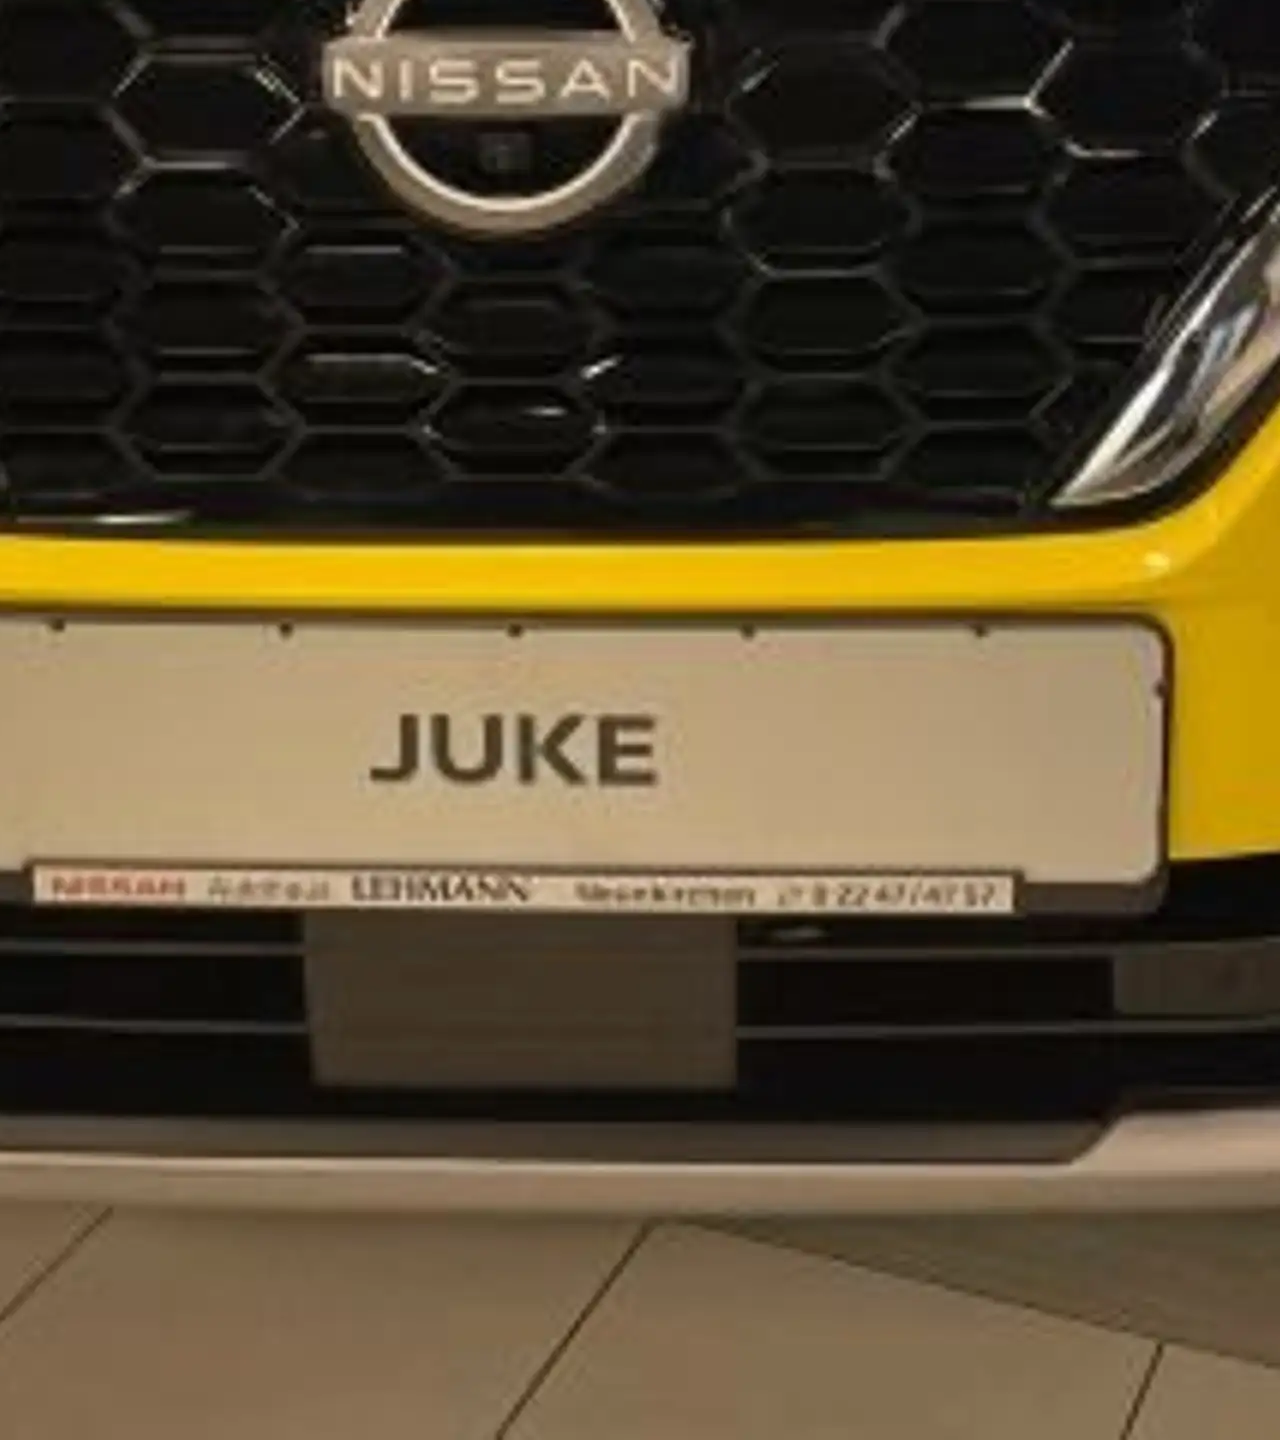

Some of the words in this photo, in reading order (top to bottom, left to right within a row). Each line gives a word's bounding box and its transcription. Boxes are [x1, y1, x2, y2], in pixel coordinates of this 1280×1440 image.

[332, 58, 679, 105] NISSAN
[369, 713, 658, 786] JUKE
[352, 875, 528, 902] LEHMANN
